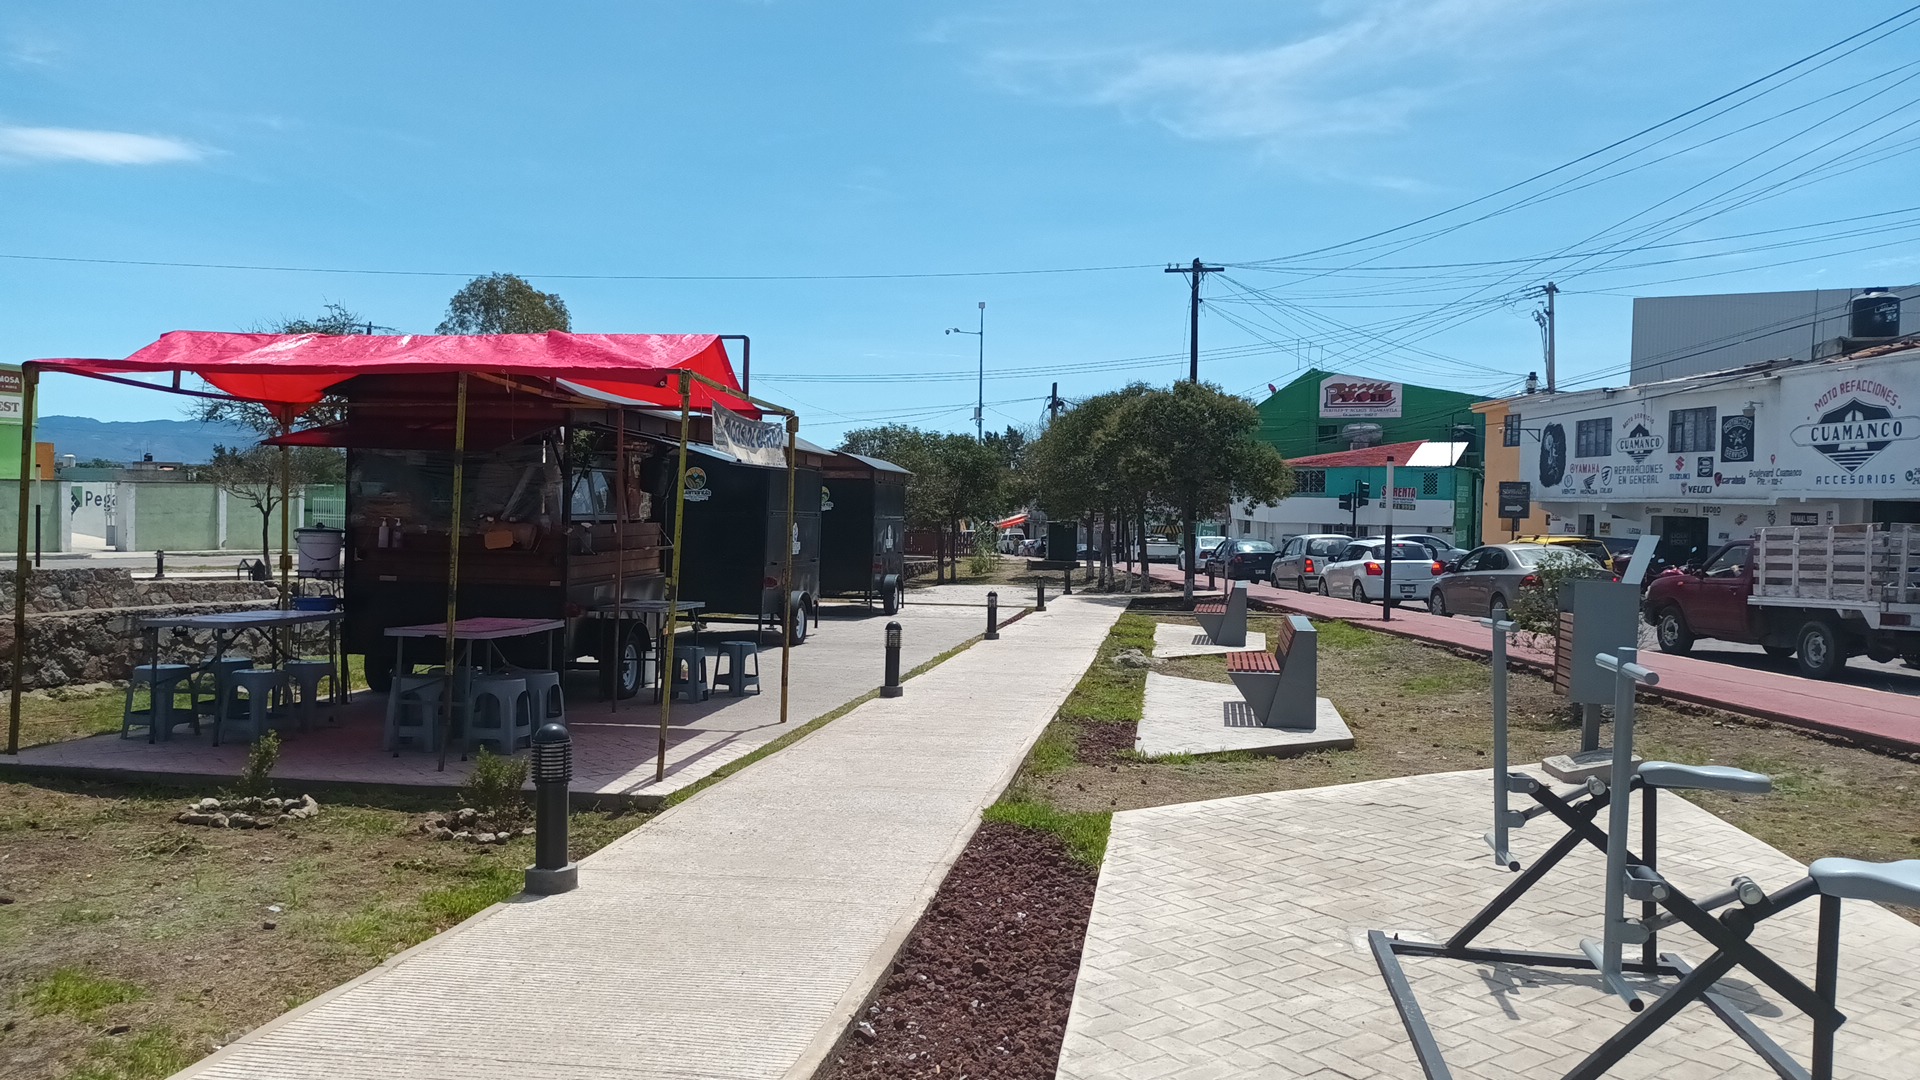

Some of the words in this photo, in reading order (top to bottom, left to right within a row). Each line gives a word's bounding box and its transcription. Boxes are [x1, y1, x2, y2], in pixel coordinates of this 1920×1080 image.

[1814, 387, 1838, 412] MOTO
[1839, 380, 1899, 407] REFACCIONES
[1811, 421, 1903, 442] CUAMANCO
[1620, 437, 1660, 450] CUAMANCO
[1575, 463, 1600, 474] YAMAHA
[1614, 464, 1664, 475] REPARACIONES
[1618, 475, 1627, 485] EN
[1629, 475, 1659, 485] GENERAL
[1816, 474, 1896, 485] ACCESORIOS
[1393, 487, 1416, 499] RENTA
[1688, 485, 1713, 494] VELOCI
